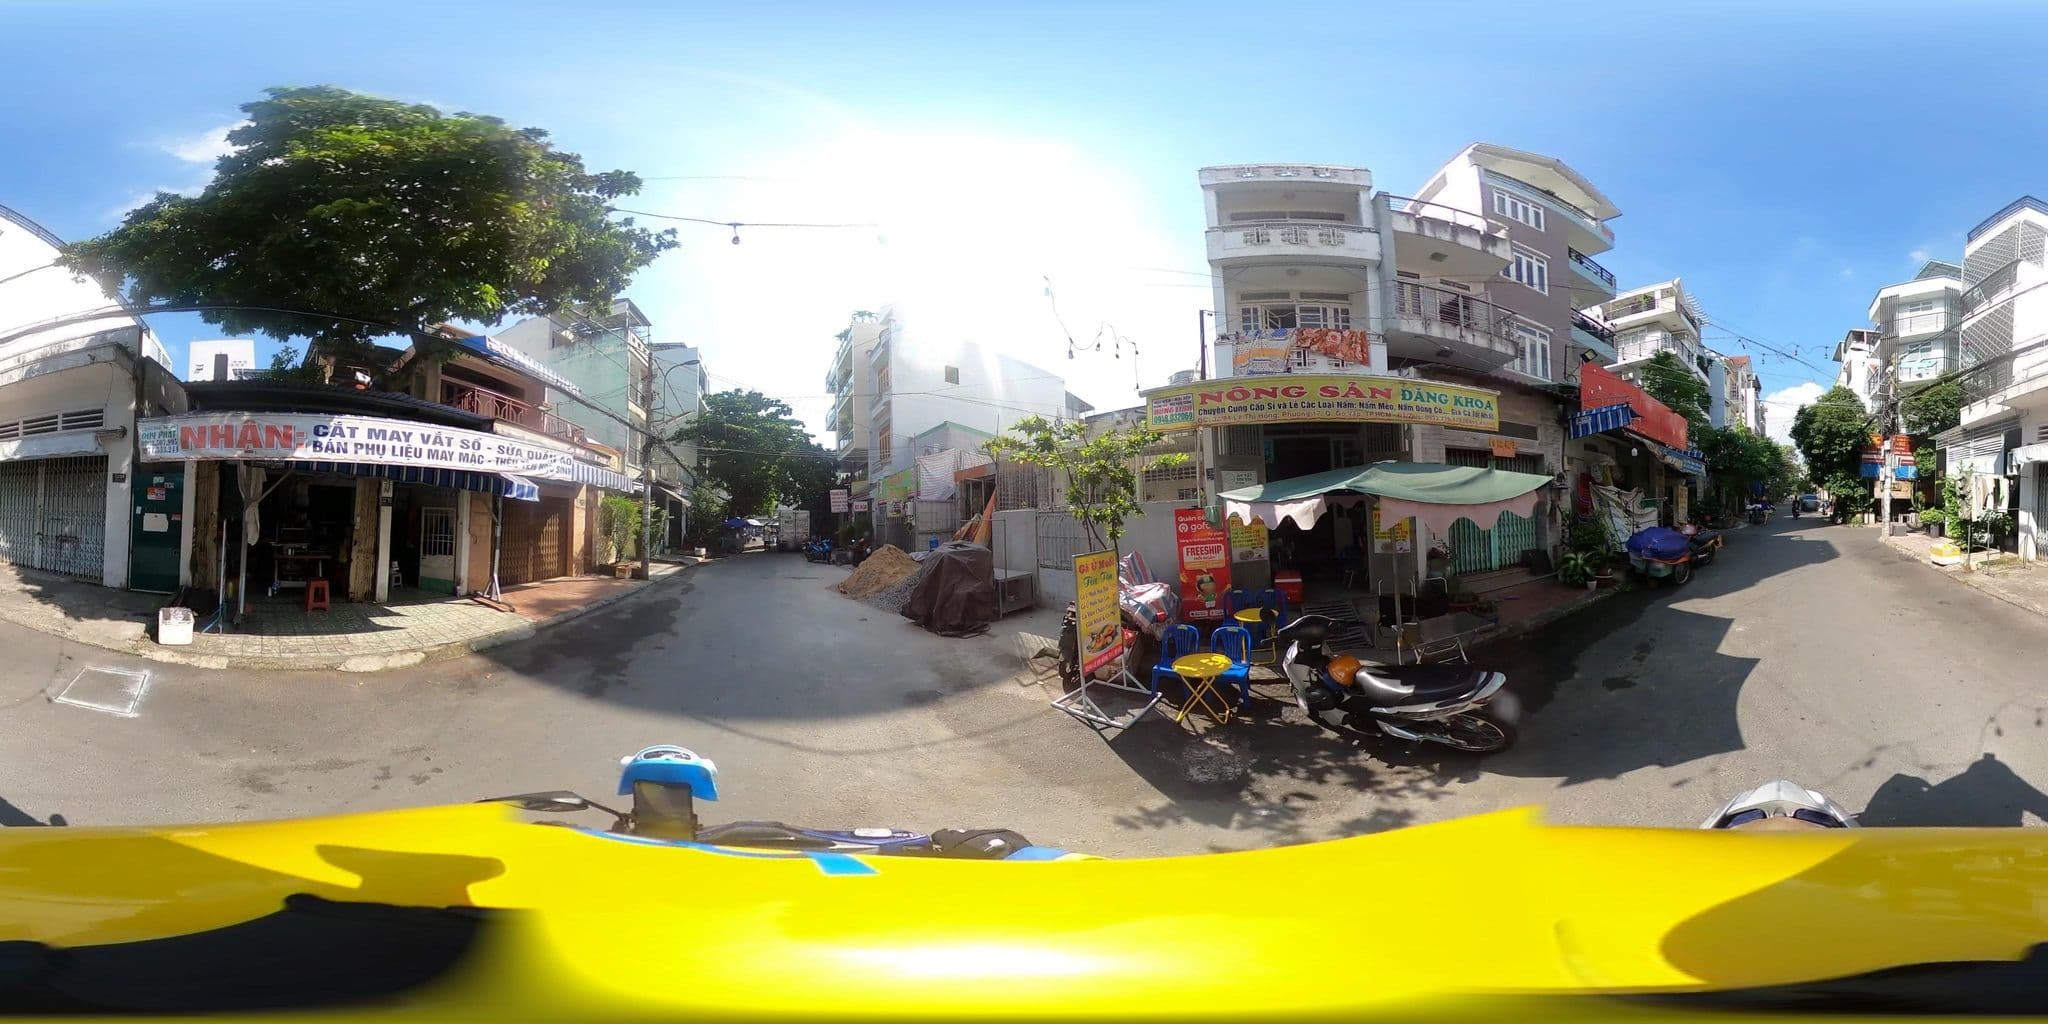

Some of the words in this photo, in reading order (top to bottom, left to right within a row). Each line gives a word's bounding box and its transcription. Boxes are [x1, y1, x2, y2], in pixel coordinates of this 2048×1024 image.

[1198, 385, 1307, 405] NÔNG
[1319, 381, 1393, 400] SẢN
[1401, 387, 1449, 405] ĐĂNG
[1453, 395, 1494, 411] KHOA
[1228, 404, 1248, 413] Cung
[313, 420, 359, 439] CẮT
[367, 427, 413, 443] MAY
[420, 431, 454, 448] VẮT
[312, 438, 348, 455] BÁN
[354, 442, 386, 460] PHỤ
[391, 443, 423, 461] LIỆU
[427, 448, 454, 462] MAY
[458, 452, 484, 467] MẶC
[1186, 545, 1222, 556] FREESHIP
